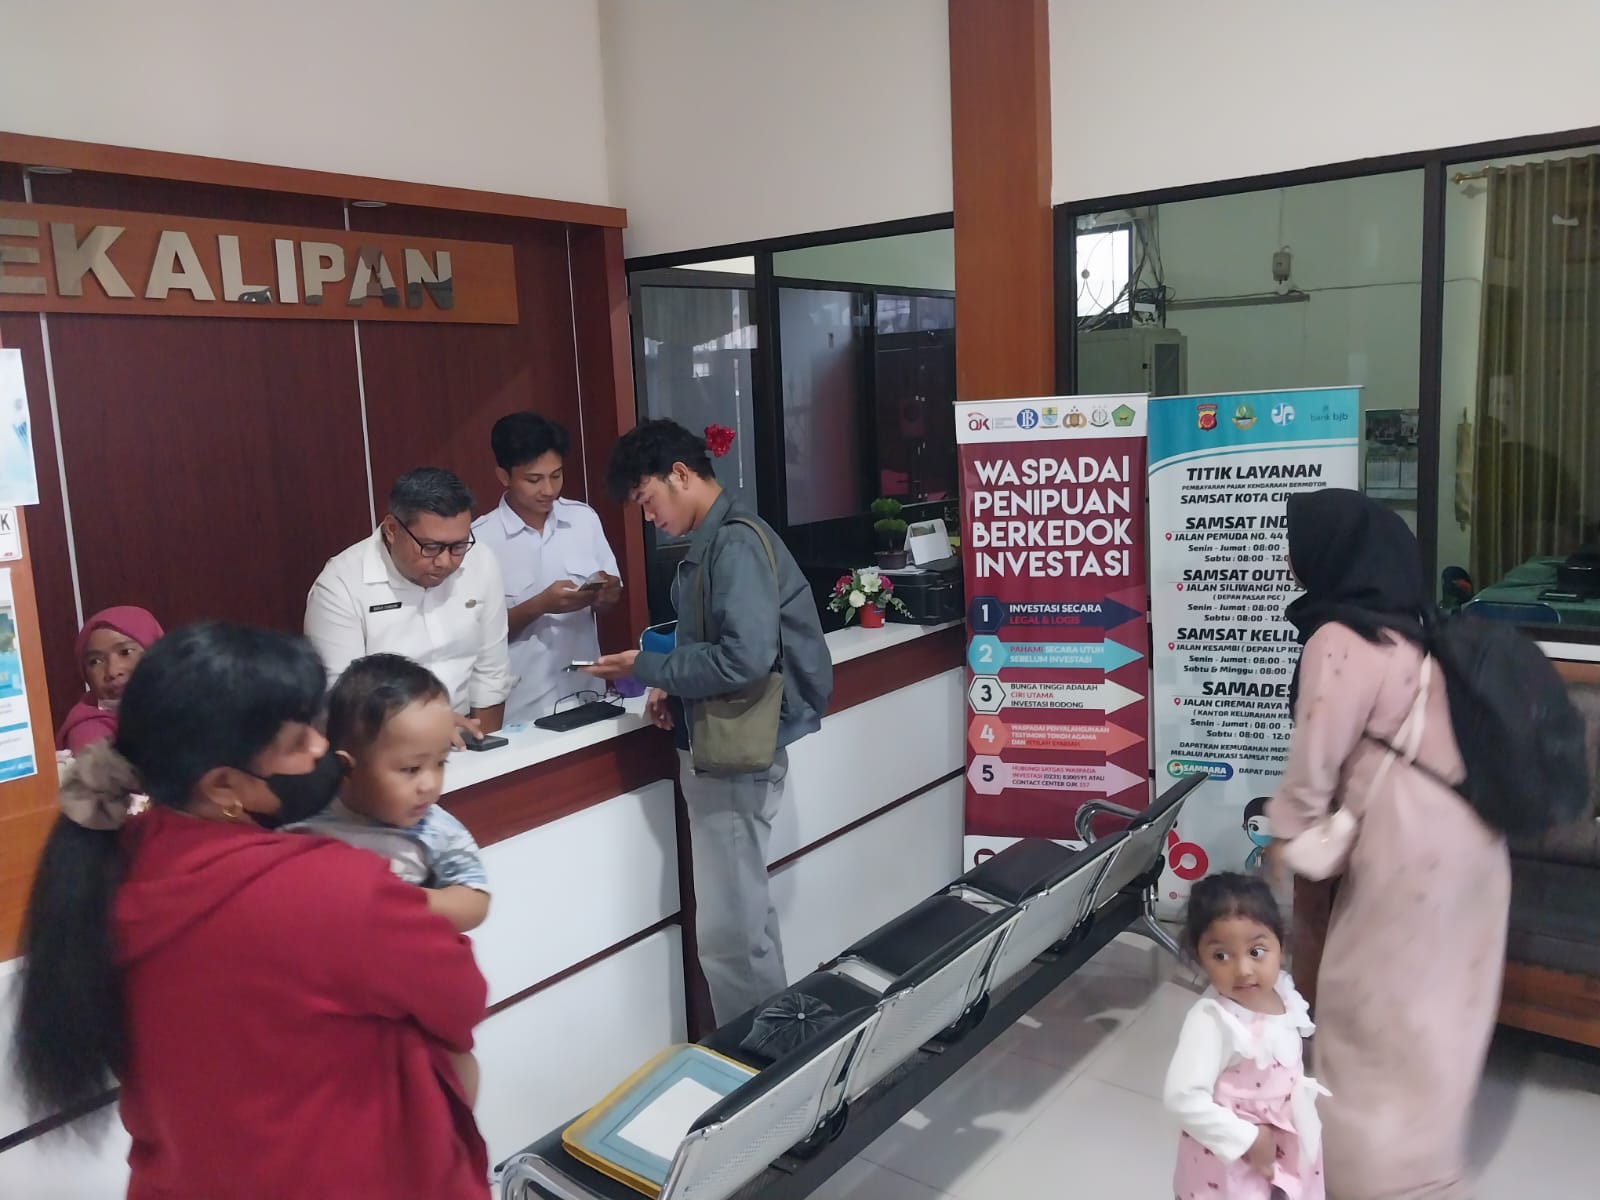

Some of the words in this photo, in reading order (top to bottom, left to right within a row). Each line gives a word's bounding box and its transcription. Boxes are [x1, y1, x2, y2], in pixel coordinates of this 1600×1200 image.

[0, 219, 454, 309] EKALIPAN
[1310, 413, 1330, 422] bank
[1333, 413, 1349, 422] bjb
[974, 455, 1130, 486] WASPADAI
[1187, 467, 1232, 481] TITIK
[1236, 464, 1322, 480] LAYANAN
[974, 487, 1130, 517] PENIPUAN
[1180, 494, 1233, 505] SAMSAT
[1235, 494, 1269, 503] KOTA
[1186, 516, 1257, 530] SAMSAT
[972, 518, 1133, 548] BERKEDOK
[1175, 533, 1205, 542] JALAN
[1206, 532, 1249, 541] PEMUDA
[1250, 532, 1268, 540] NO.
[1270, 532, 1283, 540] 44
[1188, 544, 1213, 552] Senin
[1220, 544, 1246, 552] Jumat
[1253, 544, 1280, 552] 08:00
[1204, 554, 1232, 562] Sabtu
[1237, 554, 1264, 562] 08:00
[976, 550, 1130, 578] INVESTASI
[1183, 569, 1249, 581] SAMSAT
[1252, 569, 1294, 581] OUTL
[1186, 584, 1218, 592] JALAN
[1219, 584, 1274, 592] SILIWANGI
[982, 604, 989, 622] 1
[1009, 604, 1060, 613] INVESTASI
[1062, 604, 1102, 613] SECARA
[1220, 604, 1246, 612] Jumat
[1252, 604, 1279, 612] 08:00
[1009, 616, 1040, 625] LEGAL
[1051, 616, 1081, 625] LOGIS
[1204, 614, 1230, 622] Sabtu
[1236, 614, 1263, 622] 08:00
[1176, 628, 1248, 641] SAMSAT
[1250, 630, 1298, 642] KELIL
[1045, 646, 1078, 654] SECARA
[1202, 644, 1240, 652] KESAMBI
[979, 645, 993, 663] 2
[1009, 655, 1048, 663] SEBELUM
[1049, 655, 1092, 663] INVESTASI
[1220, 656, 1247, 664] Jumat
[1253, 656, 1280, 664] 08:00
[1184, 665, 1210, 673] Sabtu
[1220, 666, 1254, 675] Minggu
[1039, 683, 1064, 691] TINGGI
[1202, 681, 1291, 698] SAMADE
[981, 684, 992, 702] 3
[1184, 698, 1213, 707] JALAN
[1214, 700, 1256, 709] CIREMAI
[1257, 701, 1282, 710] RAYA
[1230, 711, 1277, 719] KELURAHAN
[1011, 724, 1045, 732] WASPADAI
[1190, 718, 1214, 727] Senin
[1222, 720, 1248, 728] Jumat
[1254, 722, 1281, 730] 08:00
[980, 724, 995, 743] 4
[1206, 730, 1232, 738] Sabtu
[1239, 731, 1265, 740] 08:00
[1180, 742, 1220, 750] DAPATKAN
[1220, 742, 1269, 752] KEMUDAHAN
[1170, 750, 1203, 758] MELALUI
[1204, 752, 1238, 760] APLIKASI
[1239, 753, 1270, 761] SAMSAT
[982, 764, 994, 783] 5
